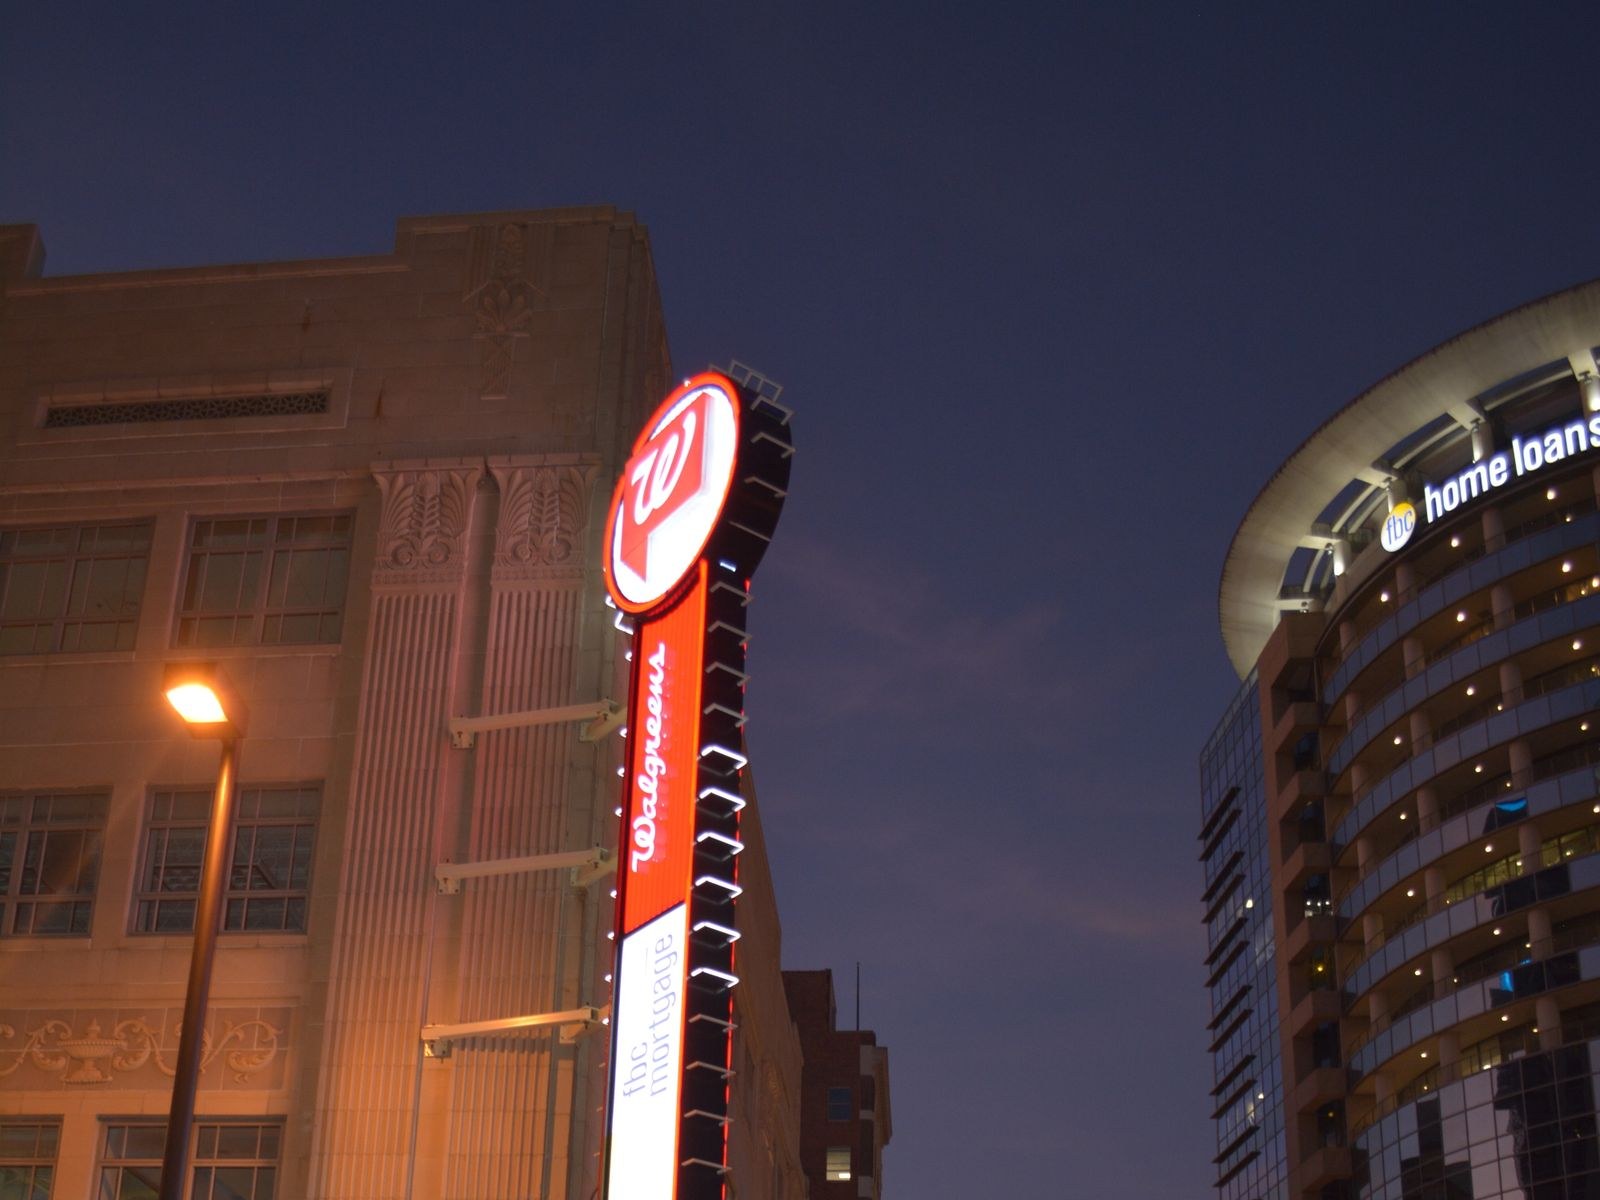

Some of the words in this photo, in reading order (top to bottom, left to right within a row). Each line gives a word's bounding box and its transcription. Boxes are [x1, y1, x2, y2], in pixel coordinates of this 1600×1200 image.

[1385, 509, 1415, 547] fbc
[1424, 454, 1509, 523] home
[1512, 416, 1600, 476] loans
[630, 641, 667, 873] Walgreens
[623, 1040, 648, 1099] fbc
[650, 932, 679, 1098] mortgage
